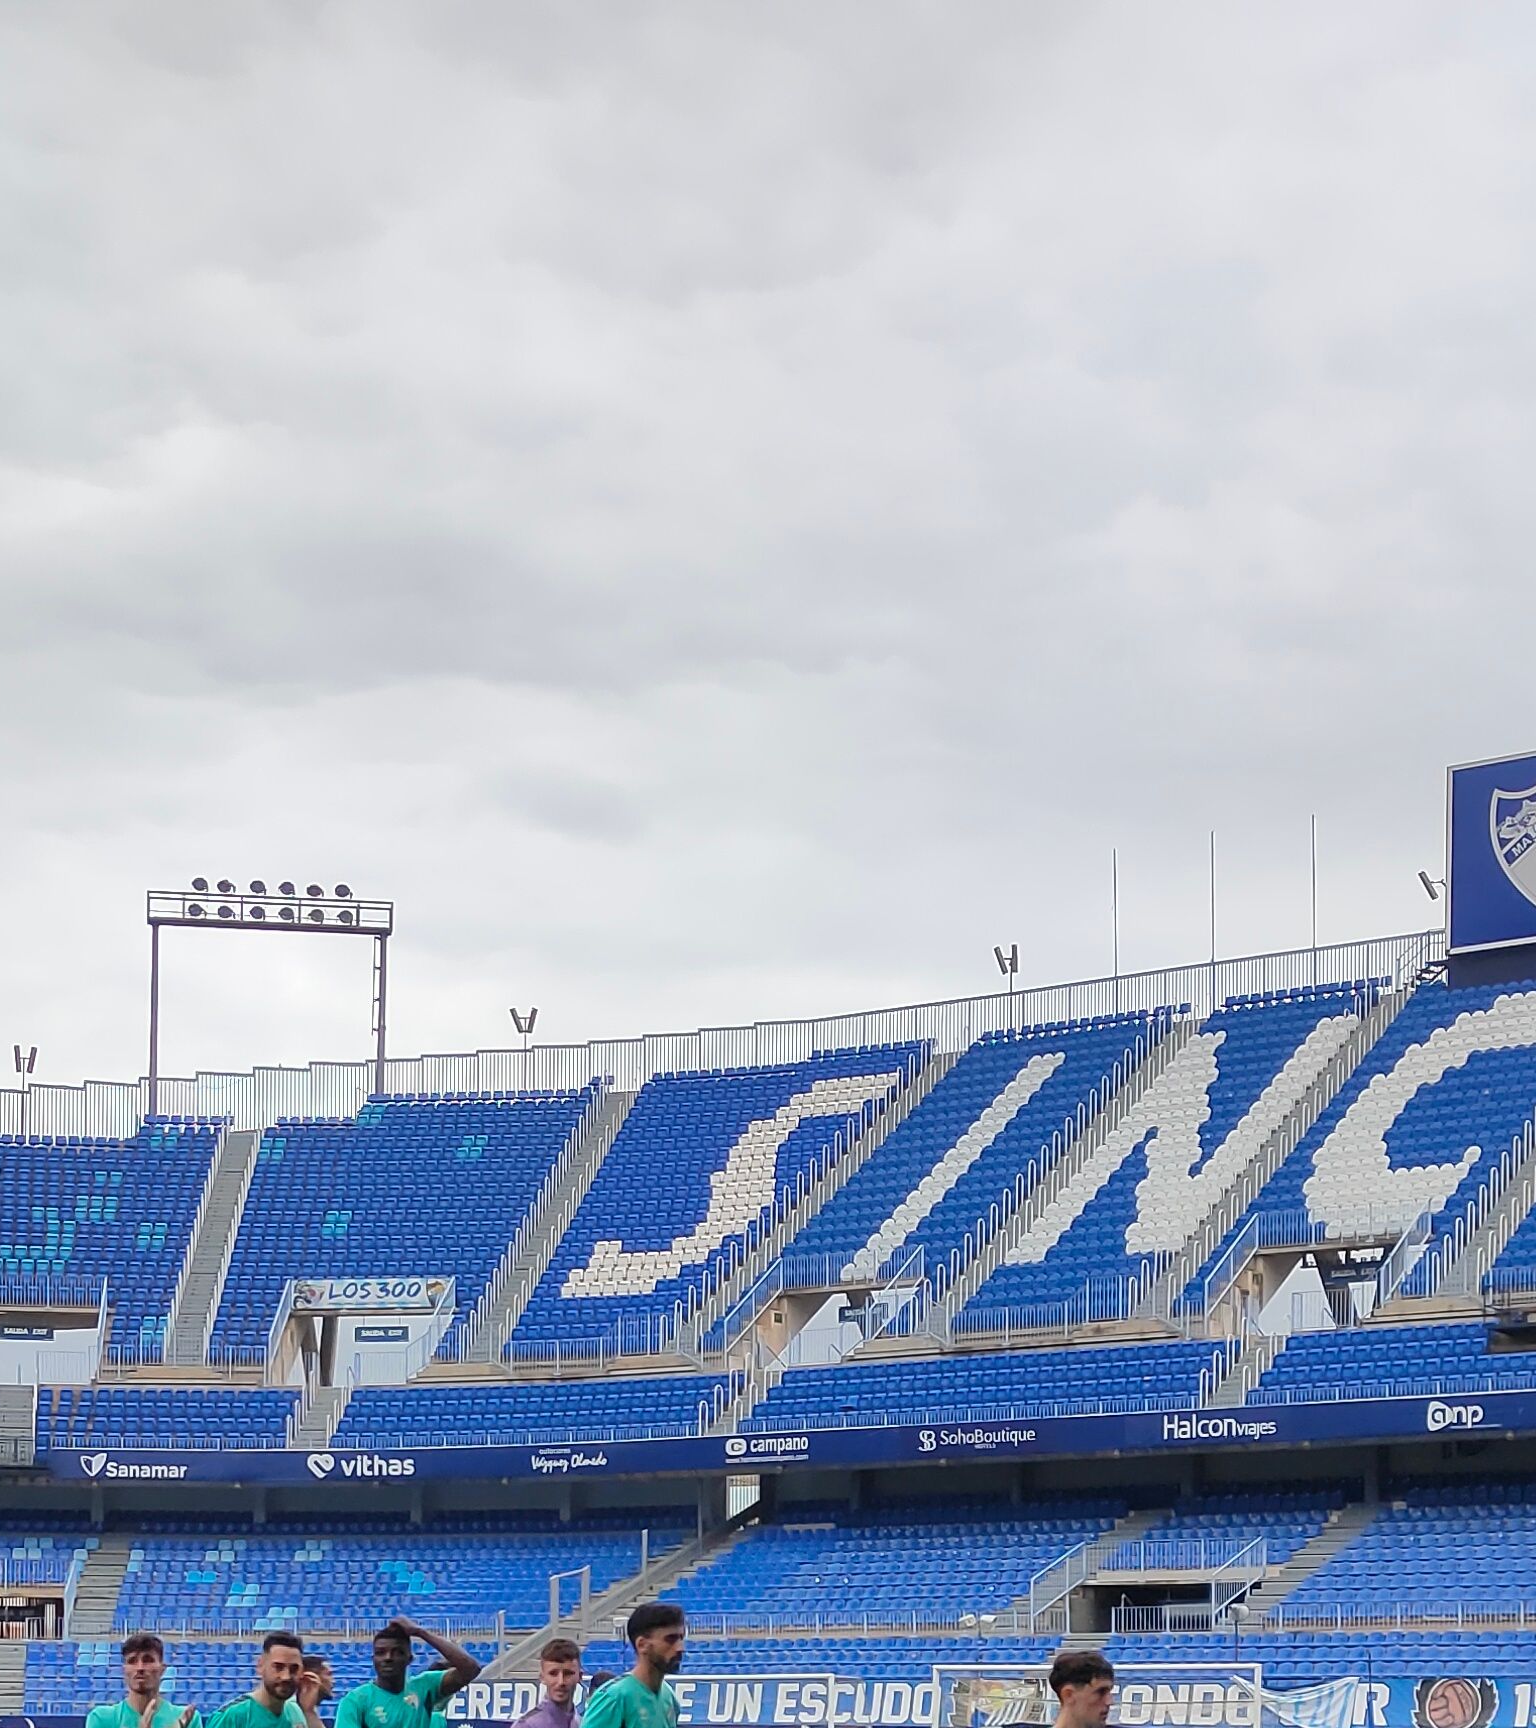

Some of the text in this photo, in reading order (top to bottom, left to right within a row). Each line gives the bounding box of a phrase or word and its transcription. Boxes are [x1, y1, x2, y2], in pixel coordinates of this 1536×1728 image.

[327, 1281, 422, 1301] LOS 300
[749, 1435, 809, 1457] campano
[105, 1460, 188, 1480] Sanamar
[340, 1452, 416, 1477] vithas
[708, 1682, 764, 1724] UN
[773, 1683, 933, 1726] ESCUDO
[1107, 1683, 1255, 1727] ONDO
